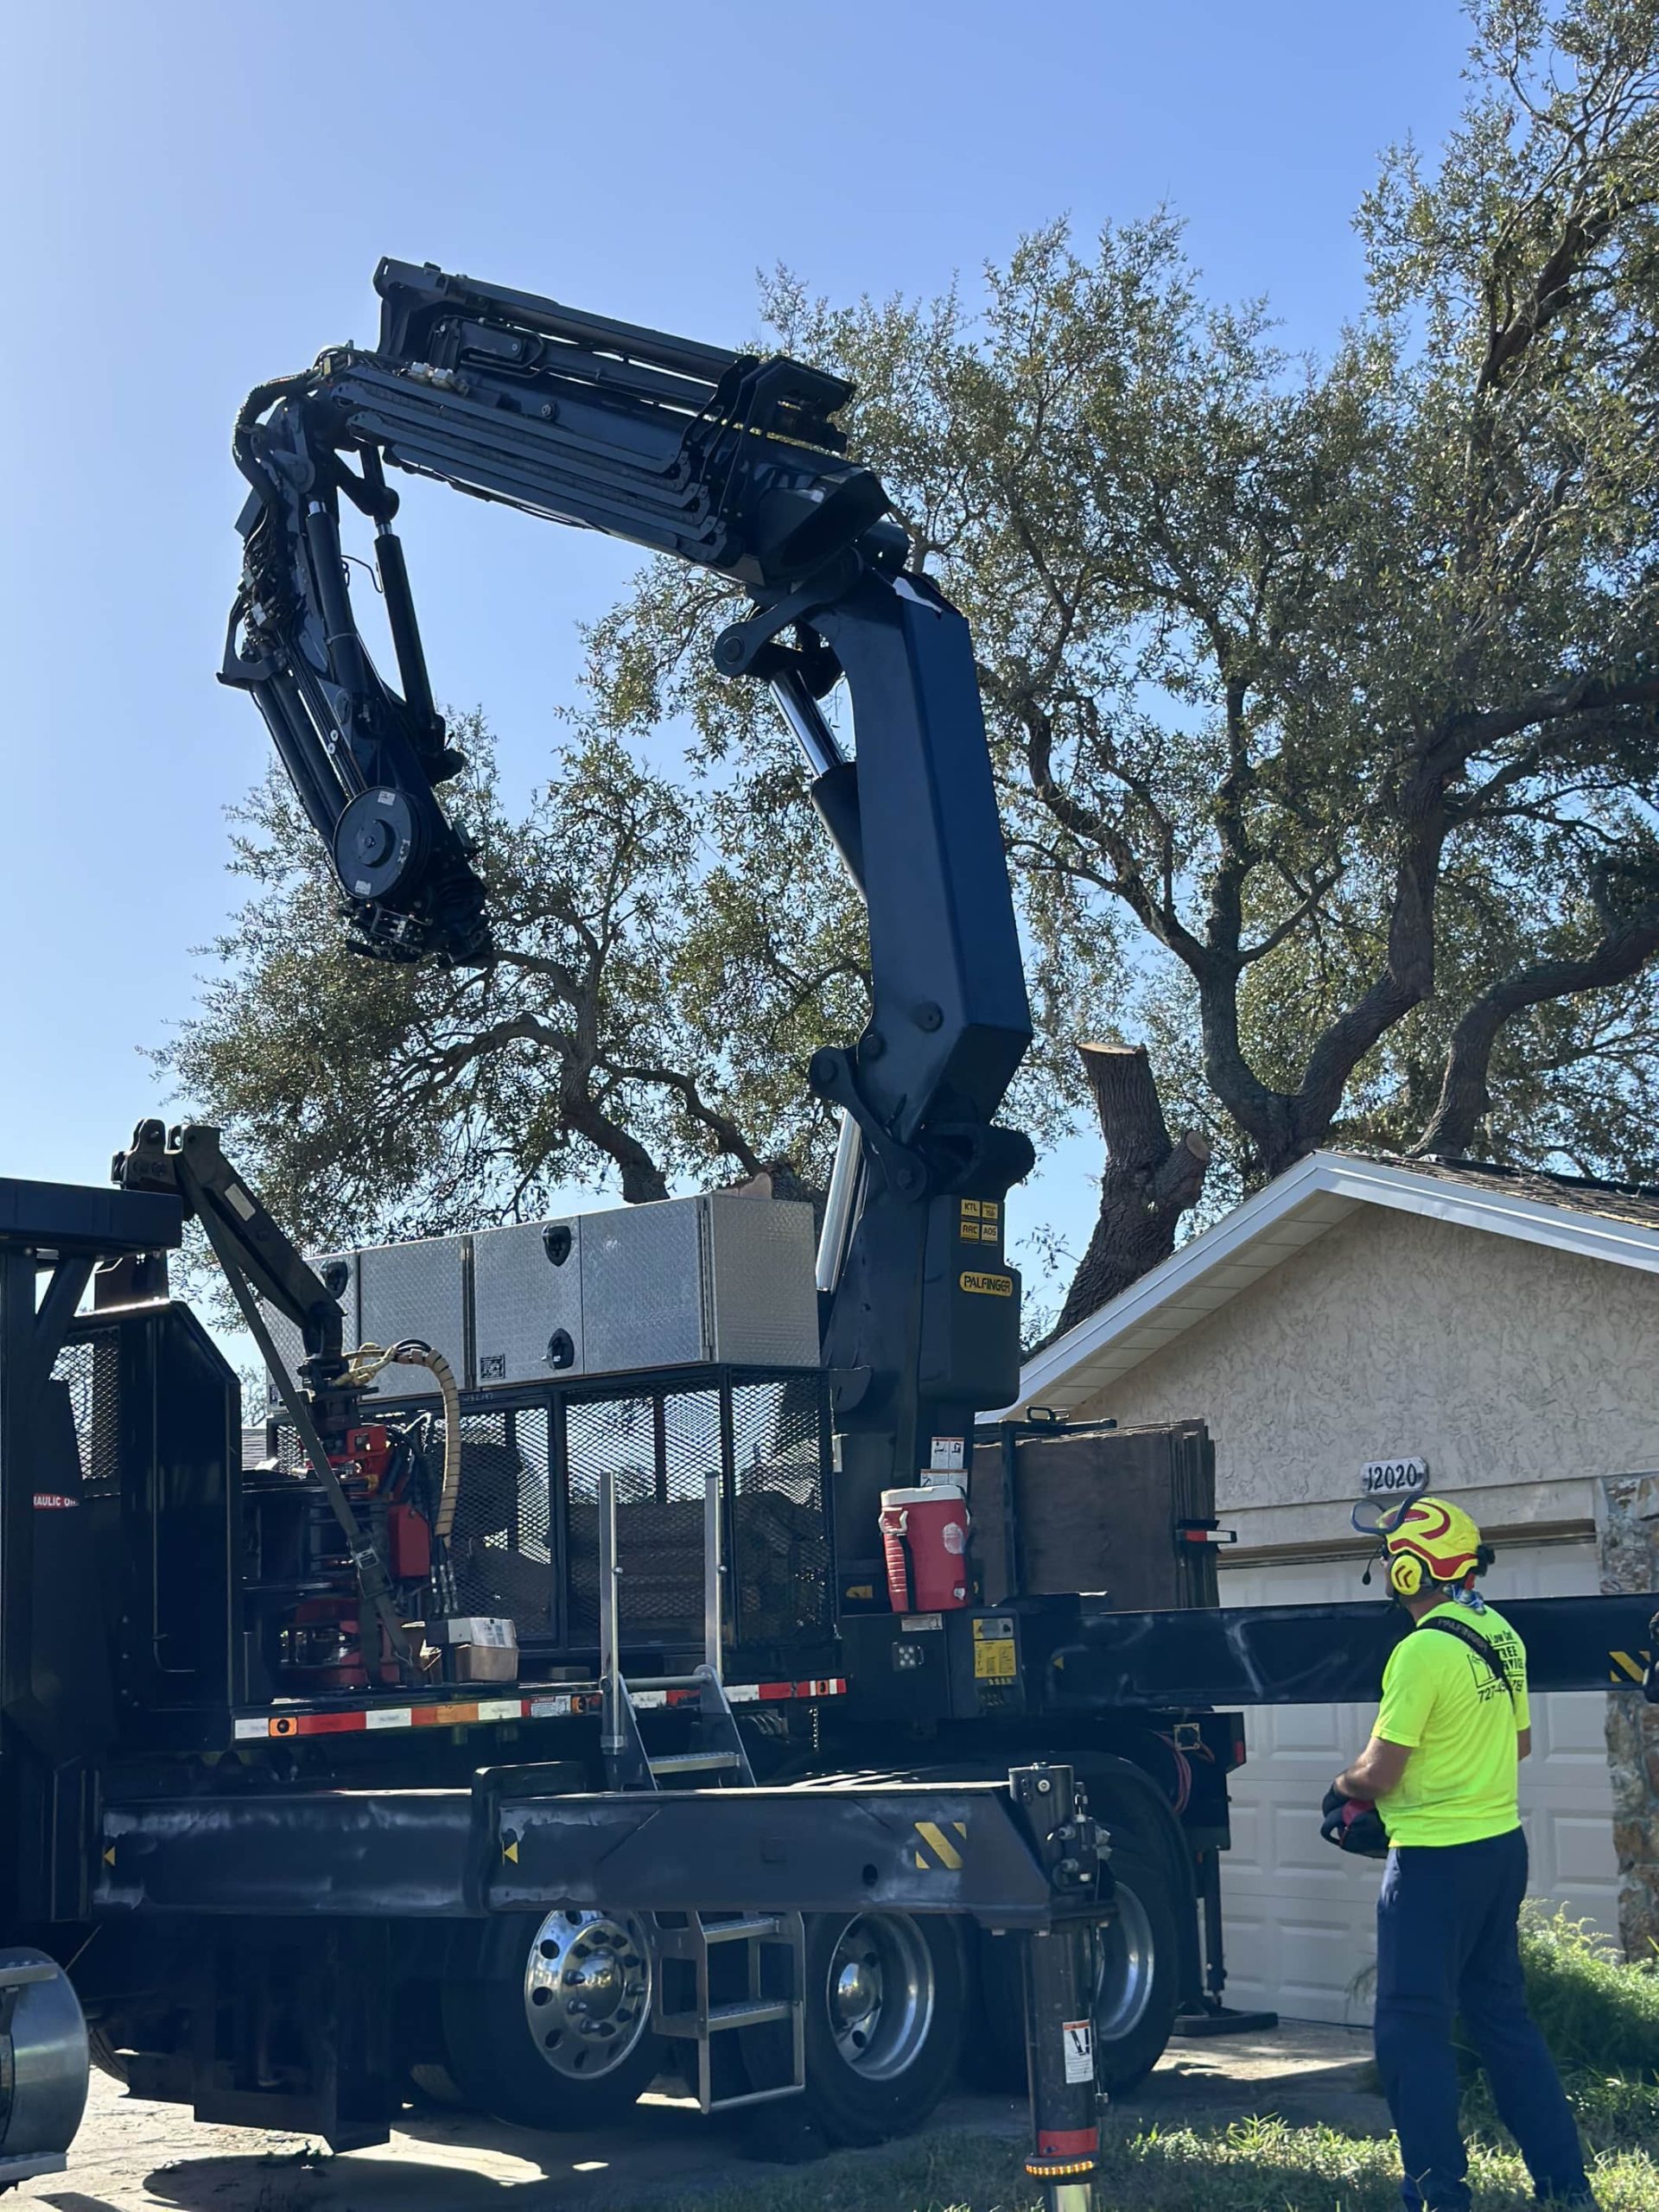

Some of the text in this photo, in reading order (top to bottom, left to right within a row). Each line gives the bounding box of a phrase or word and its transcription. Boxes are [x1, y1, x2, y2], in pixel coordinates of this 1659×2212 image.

[964, 1202, 977, 1211] KTL
[963, 1275, 1010, 1293] PALFINGER
[1368, 1463, 1417, 1491] 12020
